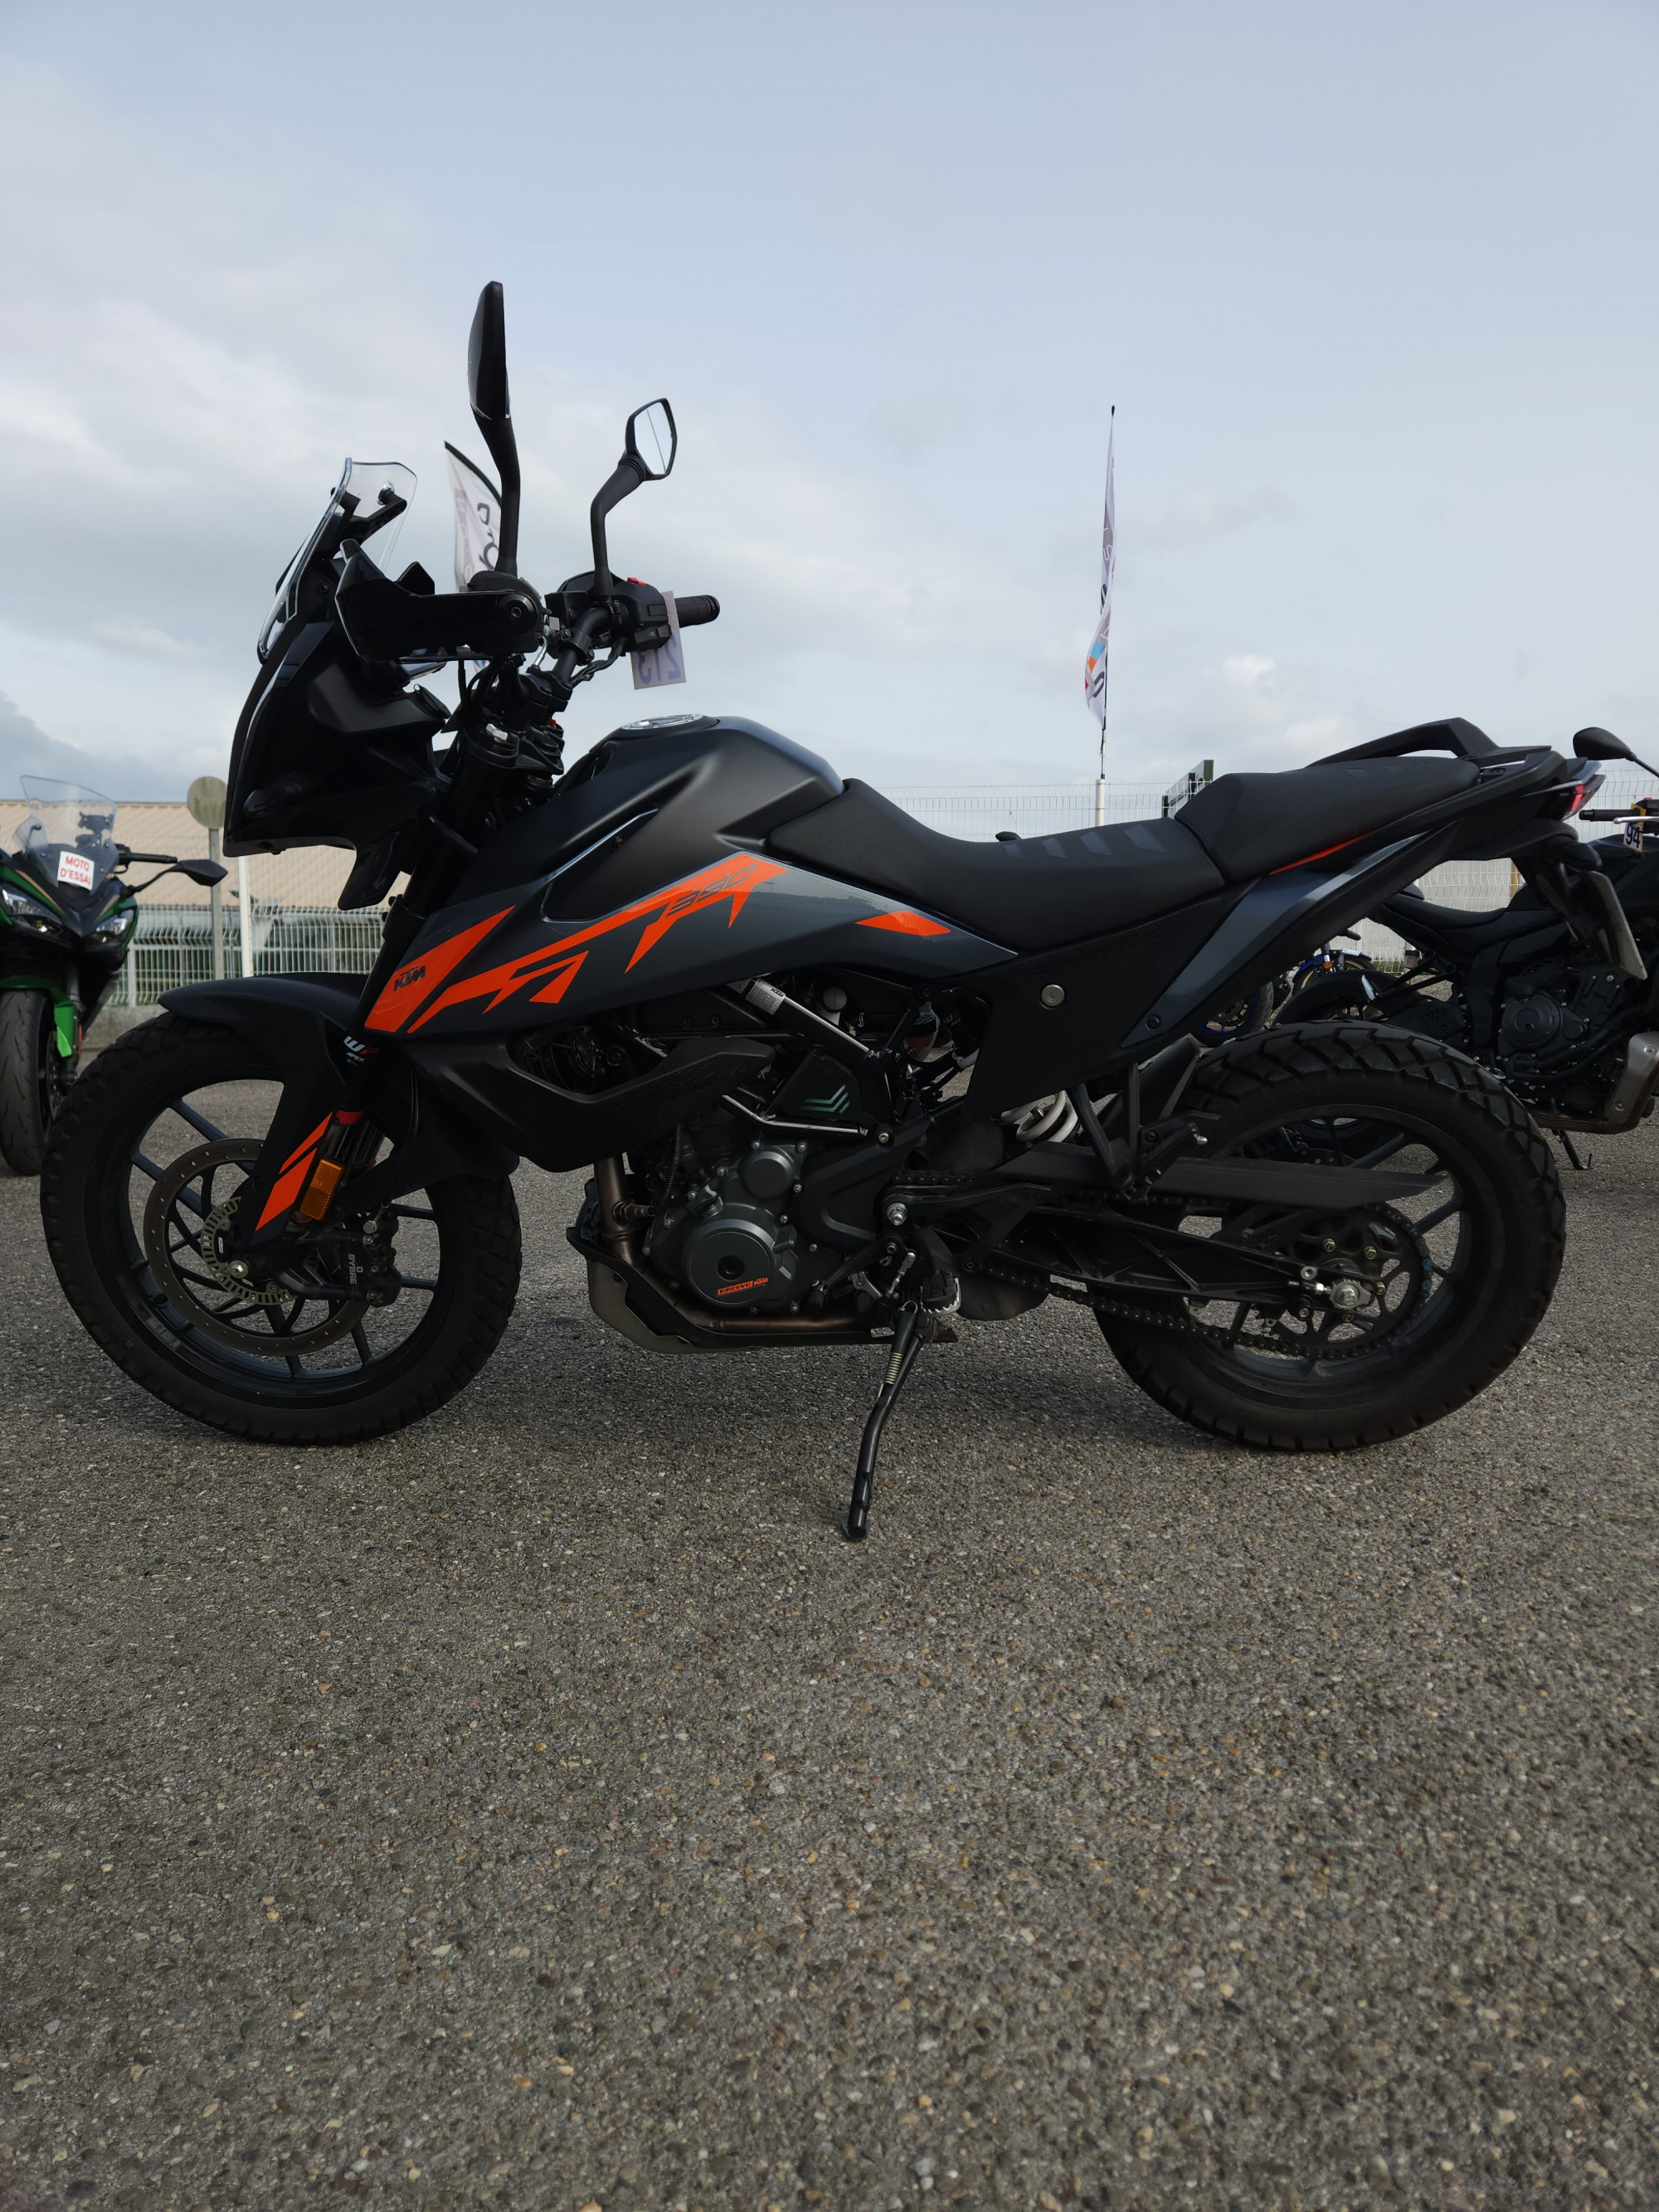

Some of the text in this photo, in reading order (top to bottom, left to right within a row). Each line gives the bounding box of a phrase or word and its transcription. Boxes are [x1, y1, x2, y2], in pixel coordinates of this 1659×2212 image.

[65, 855, 90, 872] MOTO
[60, 868, 91, 886] D'ESSAI
[665, 862, 758, 917] 390
[393, 965, 426, 993] KTM
[343, 1035, 380, 1056] WP
[345, 1052, 366, 1063] APEX
[348, 1253, 358, 1285] BYBRE
